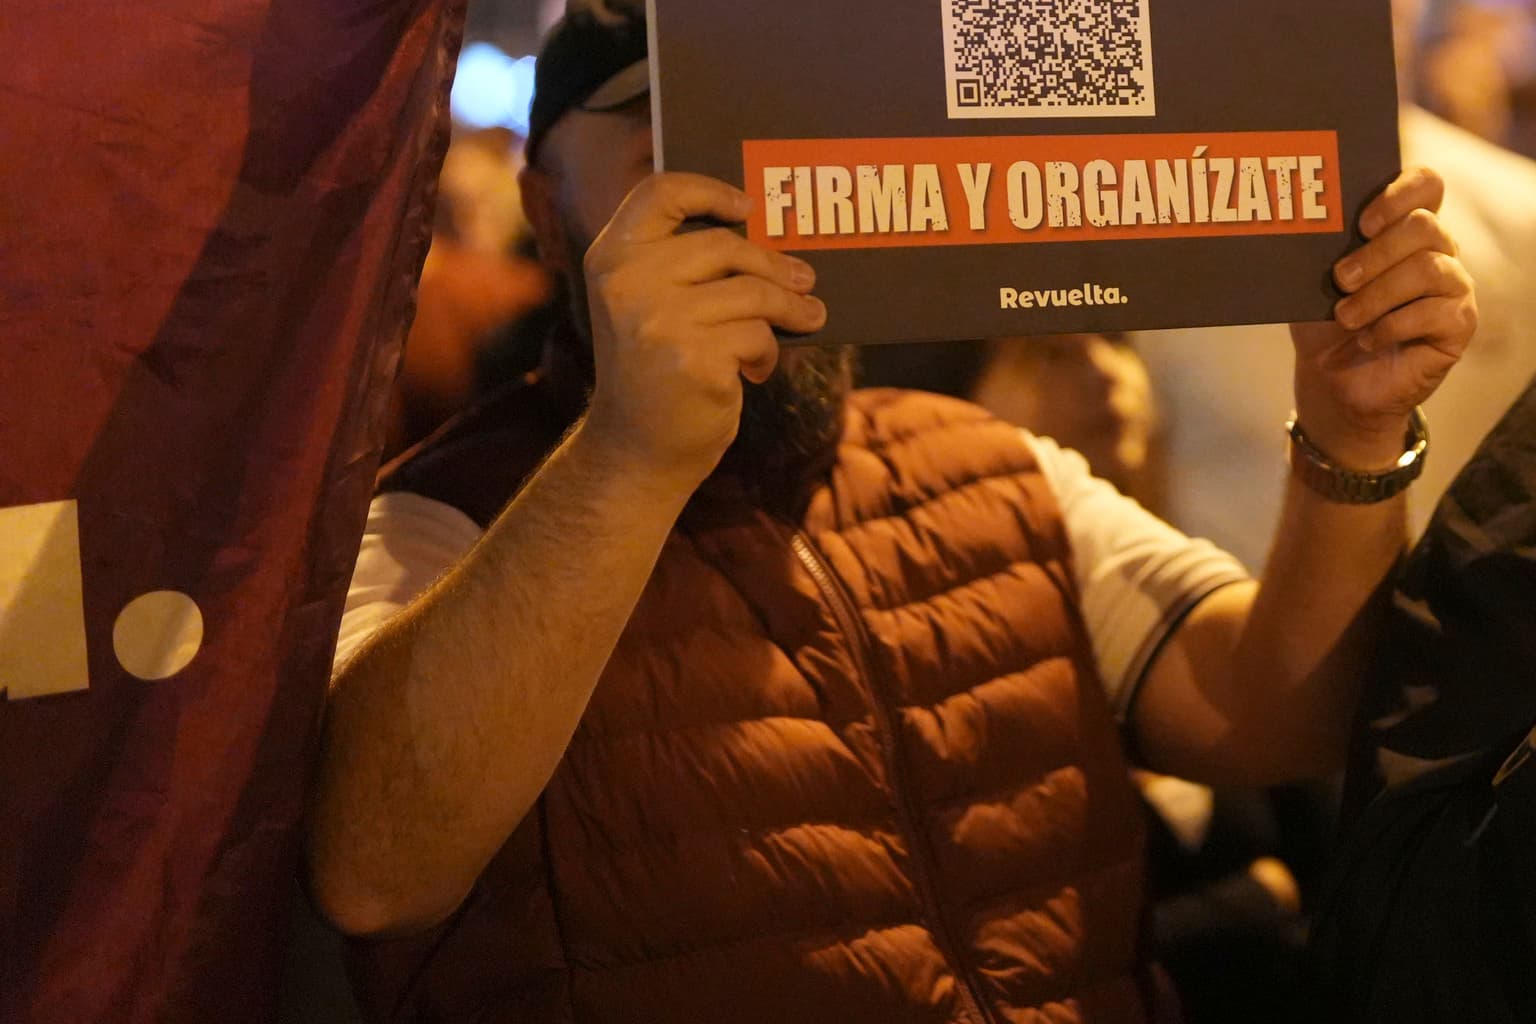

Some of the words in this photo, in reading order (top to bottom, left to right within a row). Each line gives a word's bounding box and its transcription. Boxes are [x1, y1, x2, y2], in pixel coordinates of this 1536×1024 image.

[762, 163, 949, 236] FIRMA
[956, 162, 992, 230] Y
[1006, 146, 1327, 230] ORGANÍZATE
[1000, 283, 1129, 309] Revuelta.
